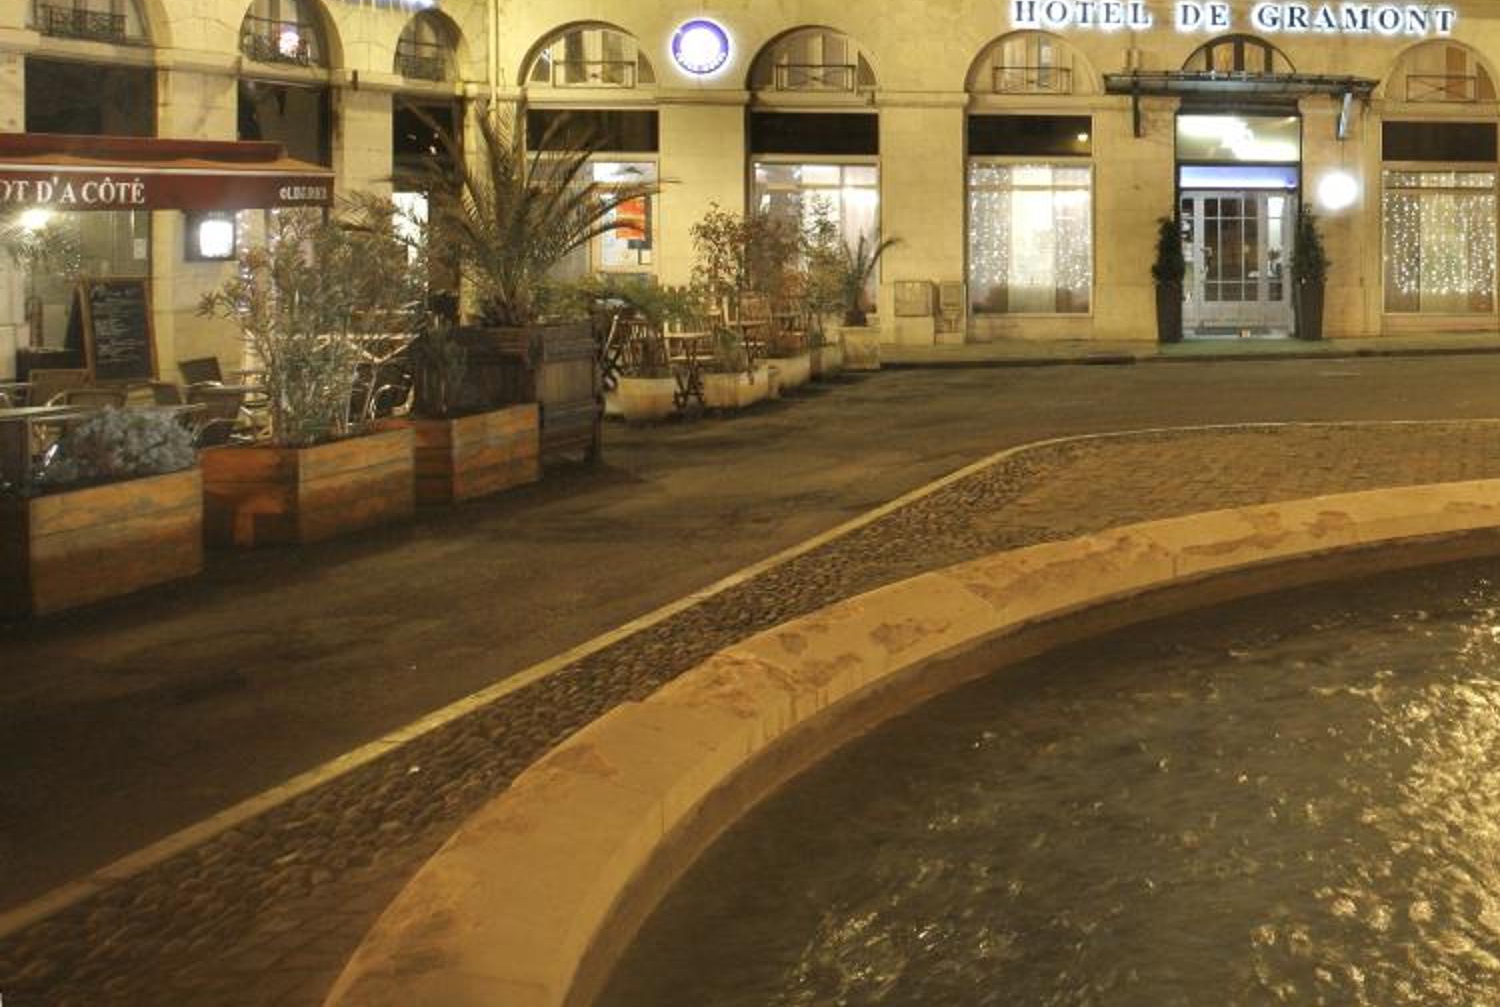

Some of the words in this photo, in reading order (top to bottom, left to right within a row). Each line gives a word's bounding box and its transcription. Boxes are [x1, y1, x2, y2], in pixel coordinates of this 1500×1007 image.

[1015, 0, 1149, 24] HOTEL
[1181, 4, 1227, 26] DE
[1257, 4, 1454, 32] GRAMONT
[81, 176, 145, 204] CÔTÉ
